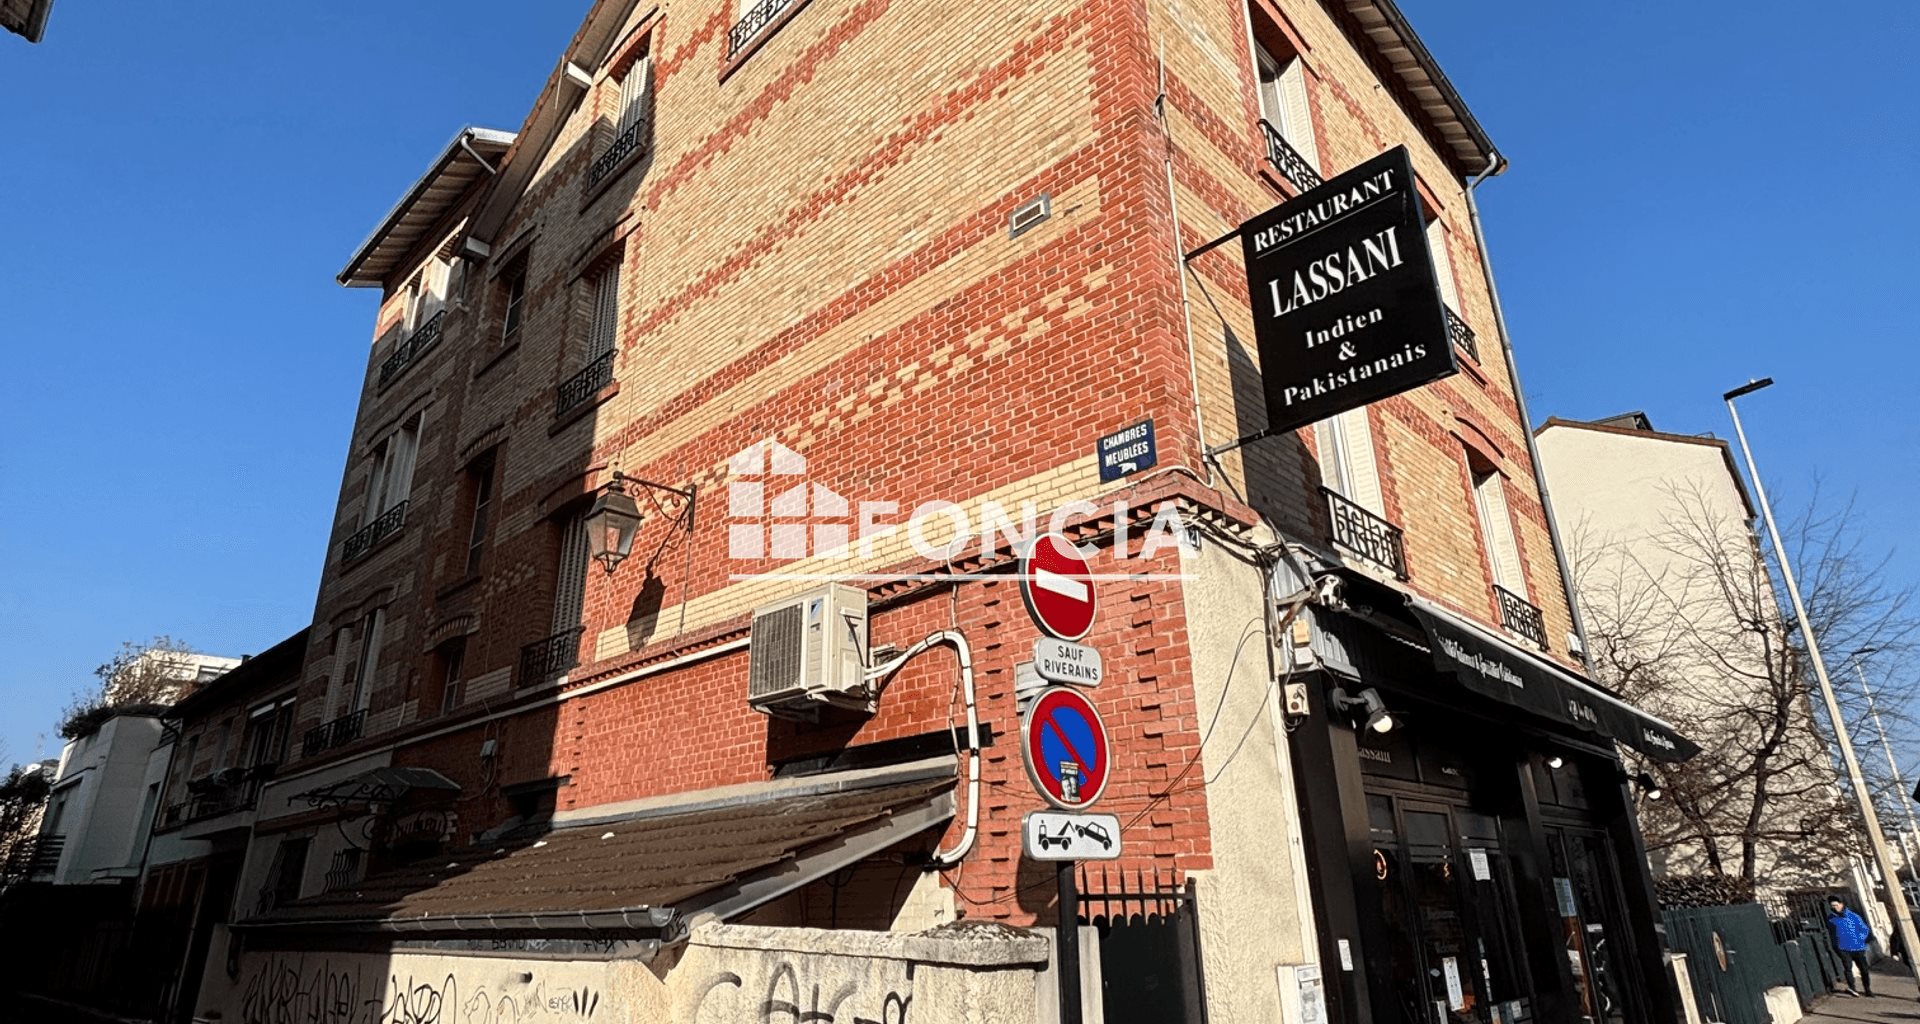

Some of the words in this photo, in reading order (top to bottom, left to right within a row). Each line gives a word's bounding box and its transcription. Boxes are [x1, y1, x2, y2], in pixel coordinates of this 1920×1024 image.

[1253, 168, 1395, 252] RESTAURANT
[1268, 225, 1404, 318] LASSANI
[1306, 307, 1384, 349] Indien
[1338, 340, 1357, 361] &
[1283, 342, 1427, 406] Pakistanais
[1103, 423, 1147, 450] CHAMBRES
[1105, 441, 1149, 467] MEUBLÉES
[1058, 645, 1084, 661] SAUF
[1043, 658, 1099, 681] RIVERAINS
